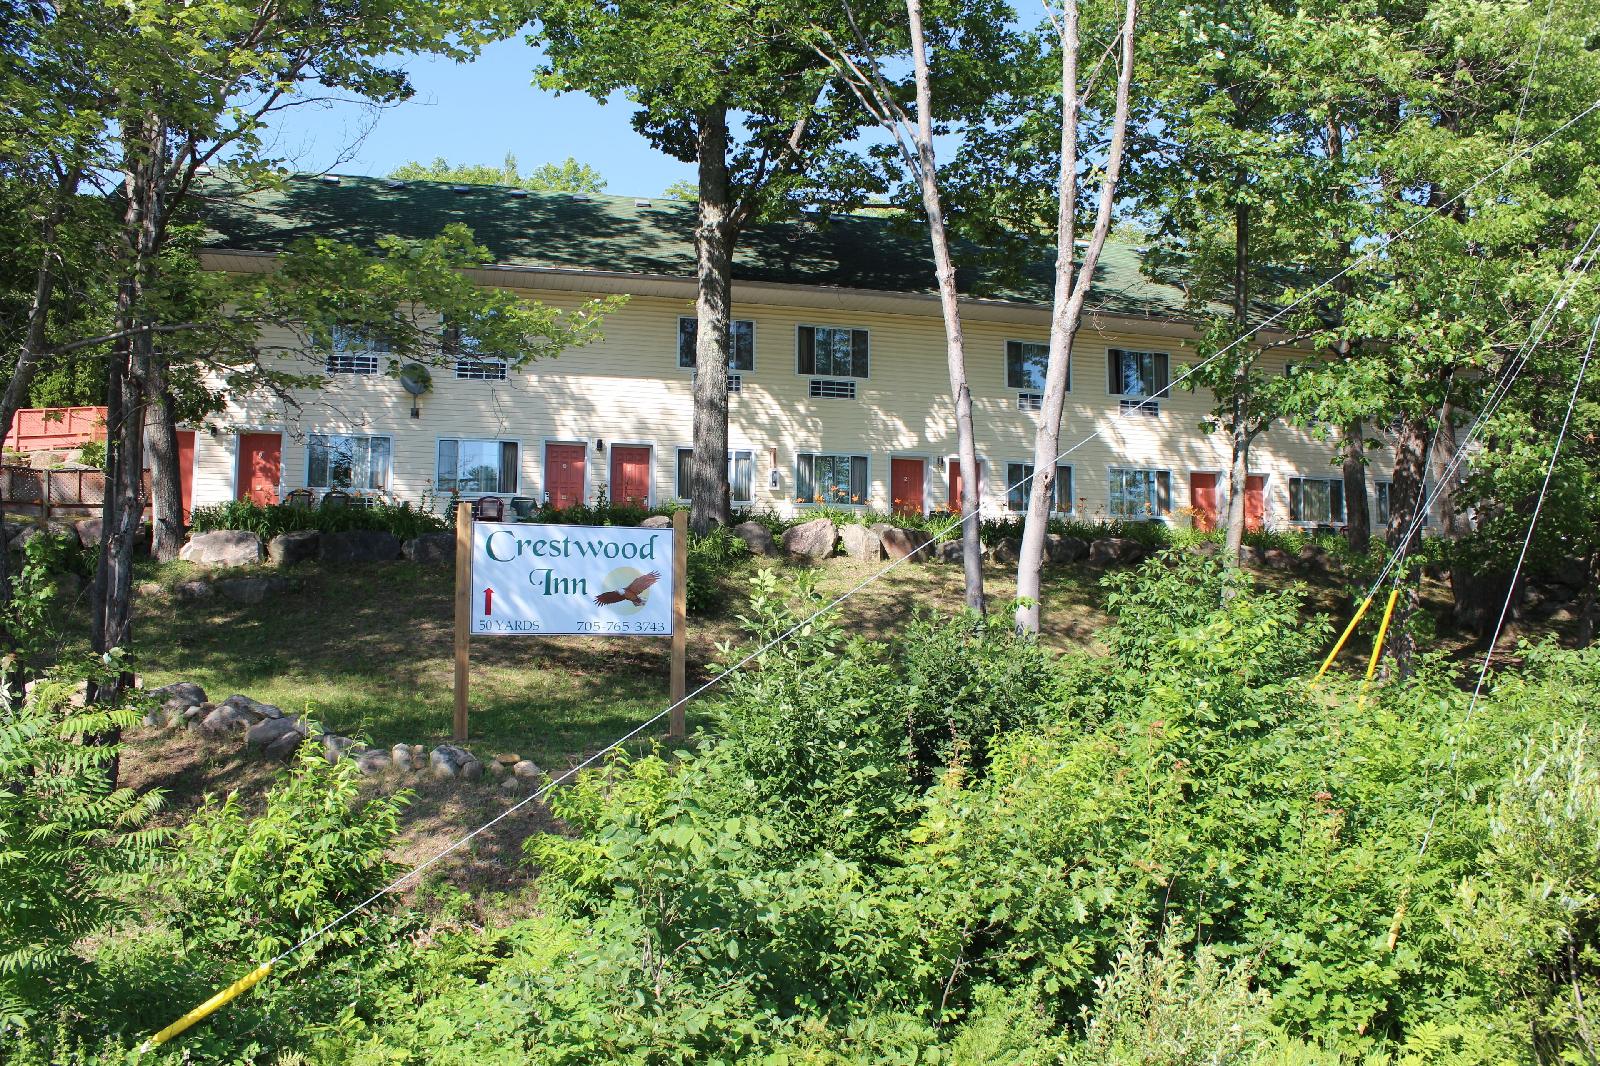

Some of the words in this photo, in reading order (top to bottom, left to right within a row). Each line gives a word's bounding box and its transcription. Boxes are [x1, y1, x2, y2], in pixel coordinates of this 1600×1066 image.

[486, 530, 659, 562] Crestwood
[529, 568, 588, 596] Inn
[479, 619, 493, 631] 50
[496, 620, 540, 631] YARDS
